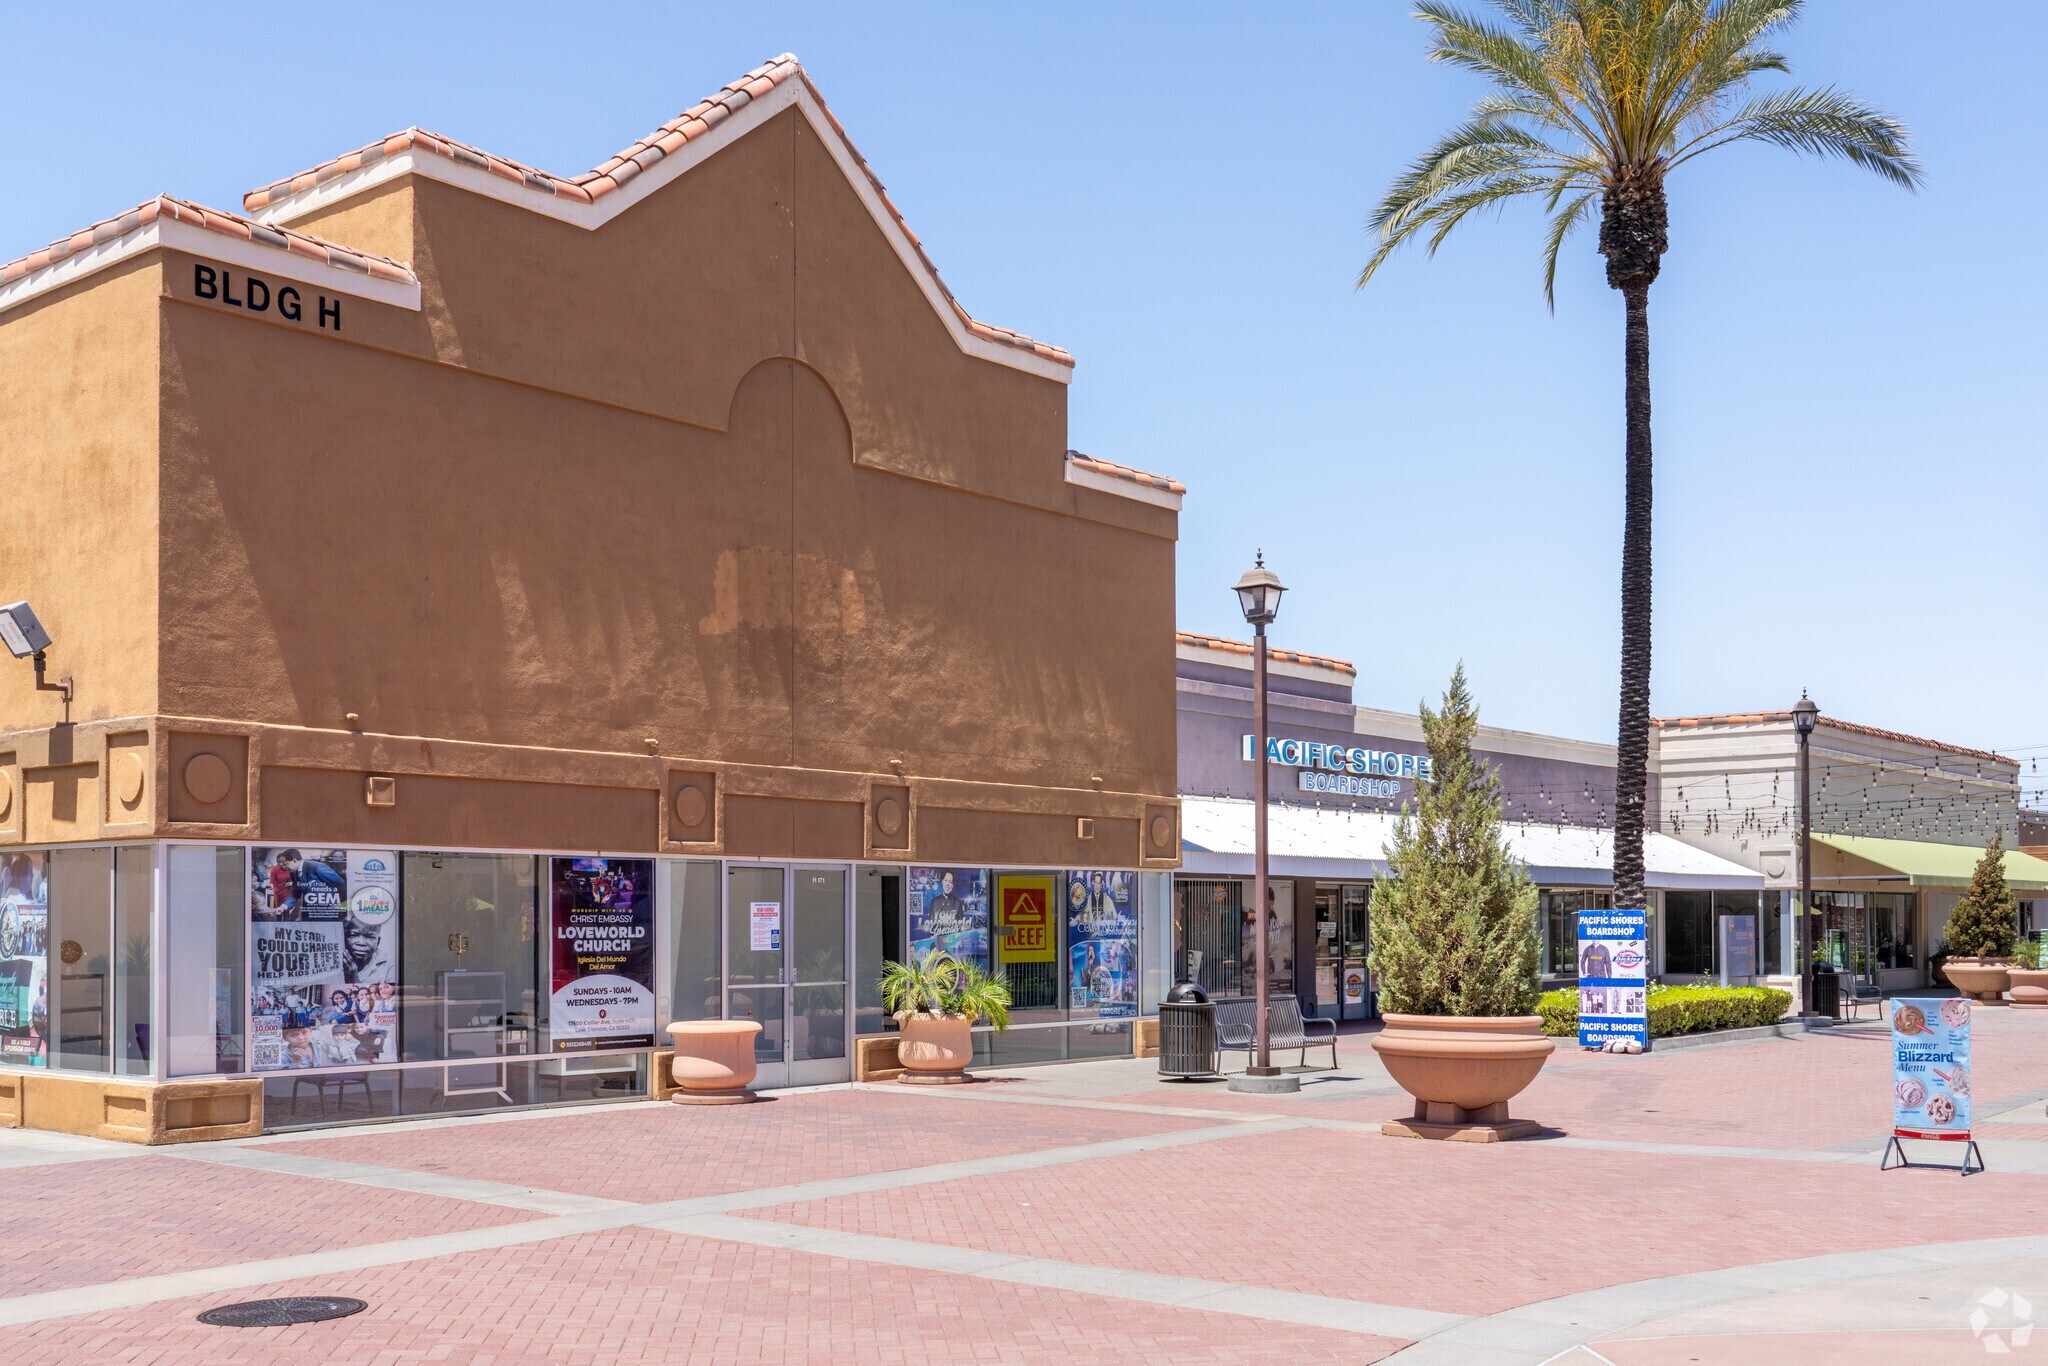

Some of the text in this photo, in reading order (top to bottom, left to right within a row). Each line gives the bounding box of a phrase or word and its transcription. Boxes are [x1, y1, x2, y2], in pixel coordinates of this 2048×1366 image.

[195, 264, 341, 331] BLDG H
[1346, 748, 1434, 784] SHORE
[1299, 772, 1400, 799] BOARDSHOP
[304, 892, 341, 904] GEM
[357, 900, 362, 911] 1
[570, 914, 633, 923] CHRIST EMBASSY
[1579, 916, 1643, 925] PACIFIC SHORES
[275, 927, 326, 943] MY STORY
[557, 926, 645, 939] LOVEWORLD
[1586, 927, 1635, 936] BOARDSHOP
[257, 938, 339, 953] COULD CHANGE
[573, 940, 631, 952] CHURCH
[257, 951, 340, 972] YOUR LIFE
[577, 956, 596, 965] Iglesia
[589, 963, 599, 971] Del
[257, 971, 284, 979] HELP
[288, 970, 309, 978] KIDS
[573, 987, 608, 996] SUNDAYS
[613, 986, 631, 995] 10AM
[566, 998, 618, 1008] WEDNESDAYS
[623, 997, 638, 1005] 7PM
[1580, 1022, 1643, 1032] PACIFIC SHORES
[1897, 1041, 1938, 1050] Summer
[1898, 1051, 1953, 1062] Blizzard
[1897, 1062, 1926, 1072] Menu
